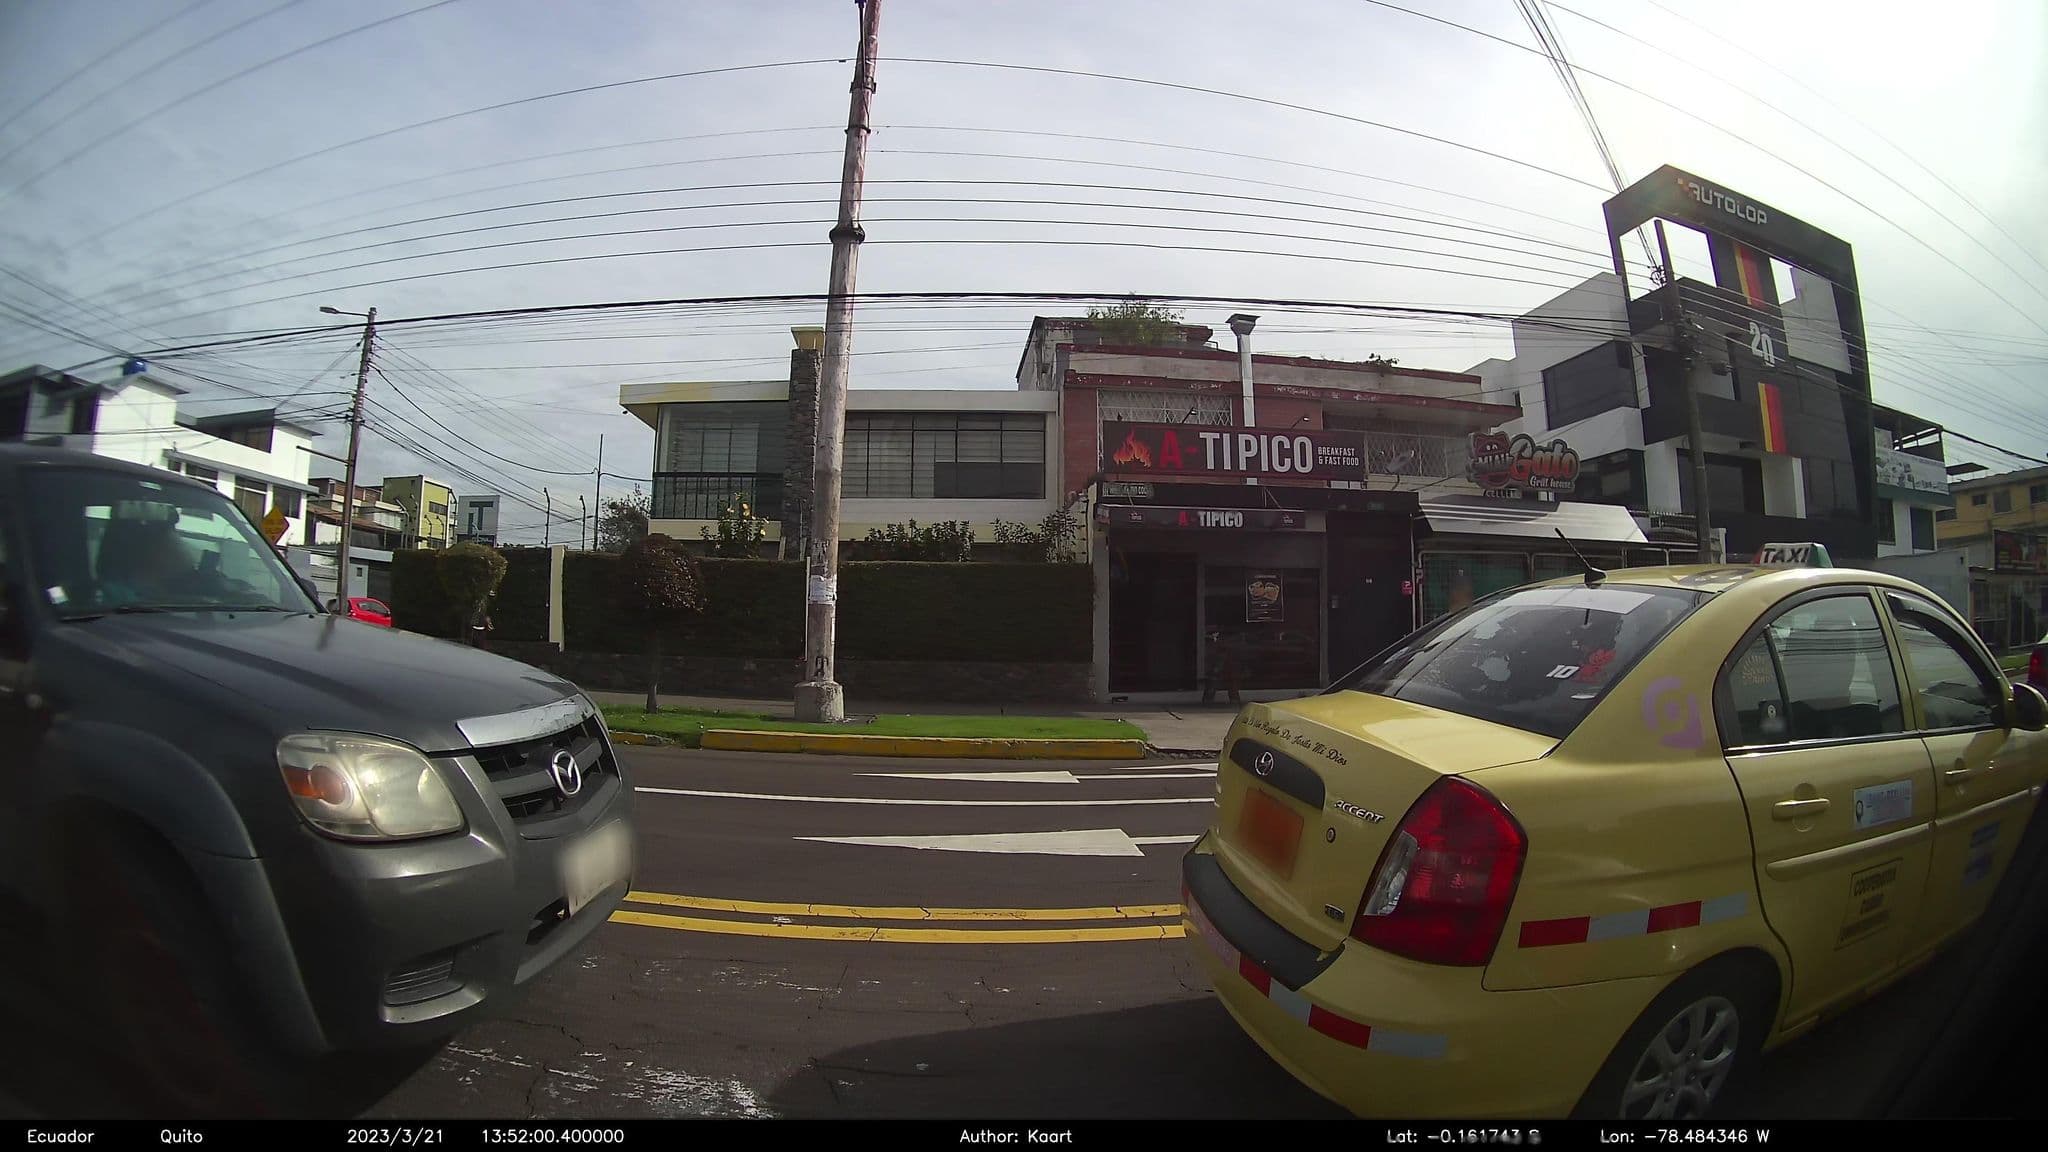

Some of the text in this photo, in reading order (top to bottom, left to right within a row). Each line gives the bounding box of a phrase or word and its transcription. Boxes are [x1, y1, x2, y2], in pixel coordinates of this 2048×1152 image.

[1317, 446, 1355, 457] BREAKFAST
[1509, 437, 1577, 481] Gato
[1325, 456, 1341, 465] FAST
[1342, 457, 1359, 466] FOOD
[1762, 547, 1811, 564] TAXI
[1545, 664, 1580, 679] 10
[1326, 747, 1349, 766] Dios
[1334, 799, 1385, 825] ACCENT
